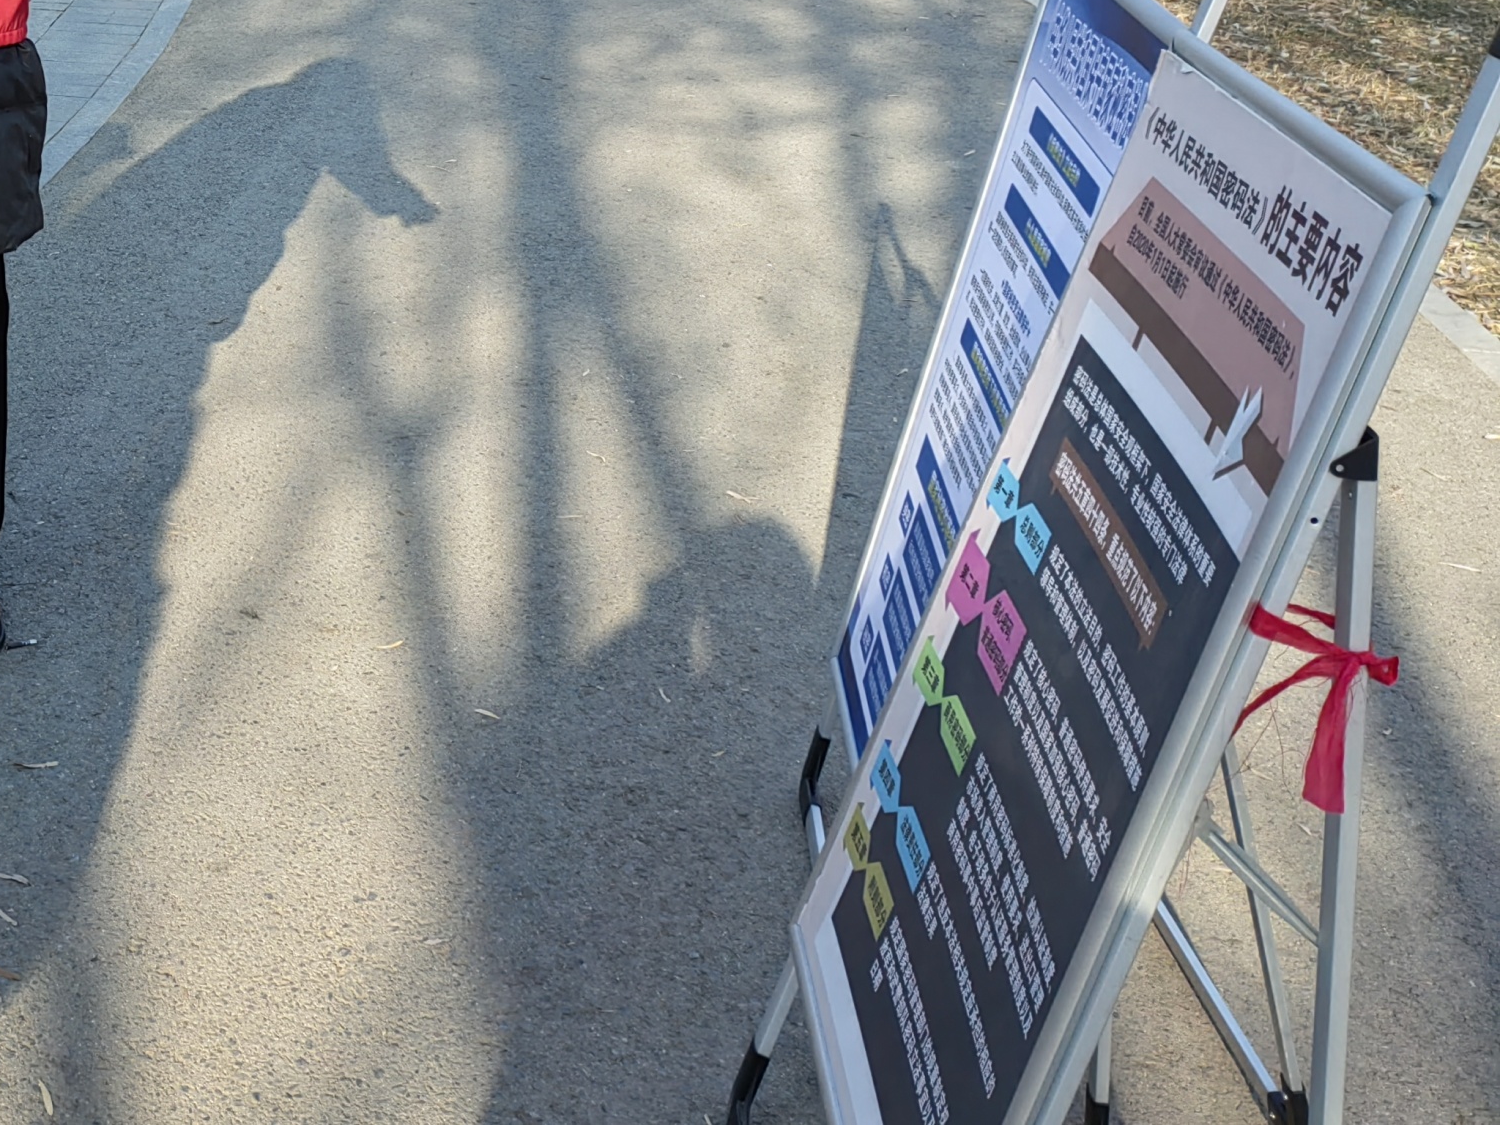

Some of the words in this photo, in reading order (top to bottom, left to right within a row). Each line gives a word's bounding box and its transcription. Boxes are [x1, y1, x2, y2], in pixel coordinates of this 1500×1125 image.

[993, 472, 1014, 511] 第一章
[1019, 512, 1044, 560] 总则部分
[958, 562, 980, 603] 第二章
[920, 653, 939, 696] 第三章
